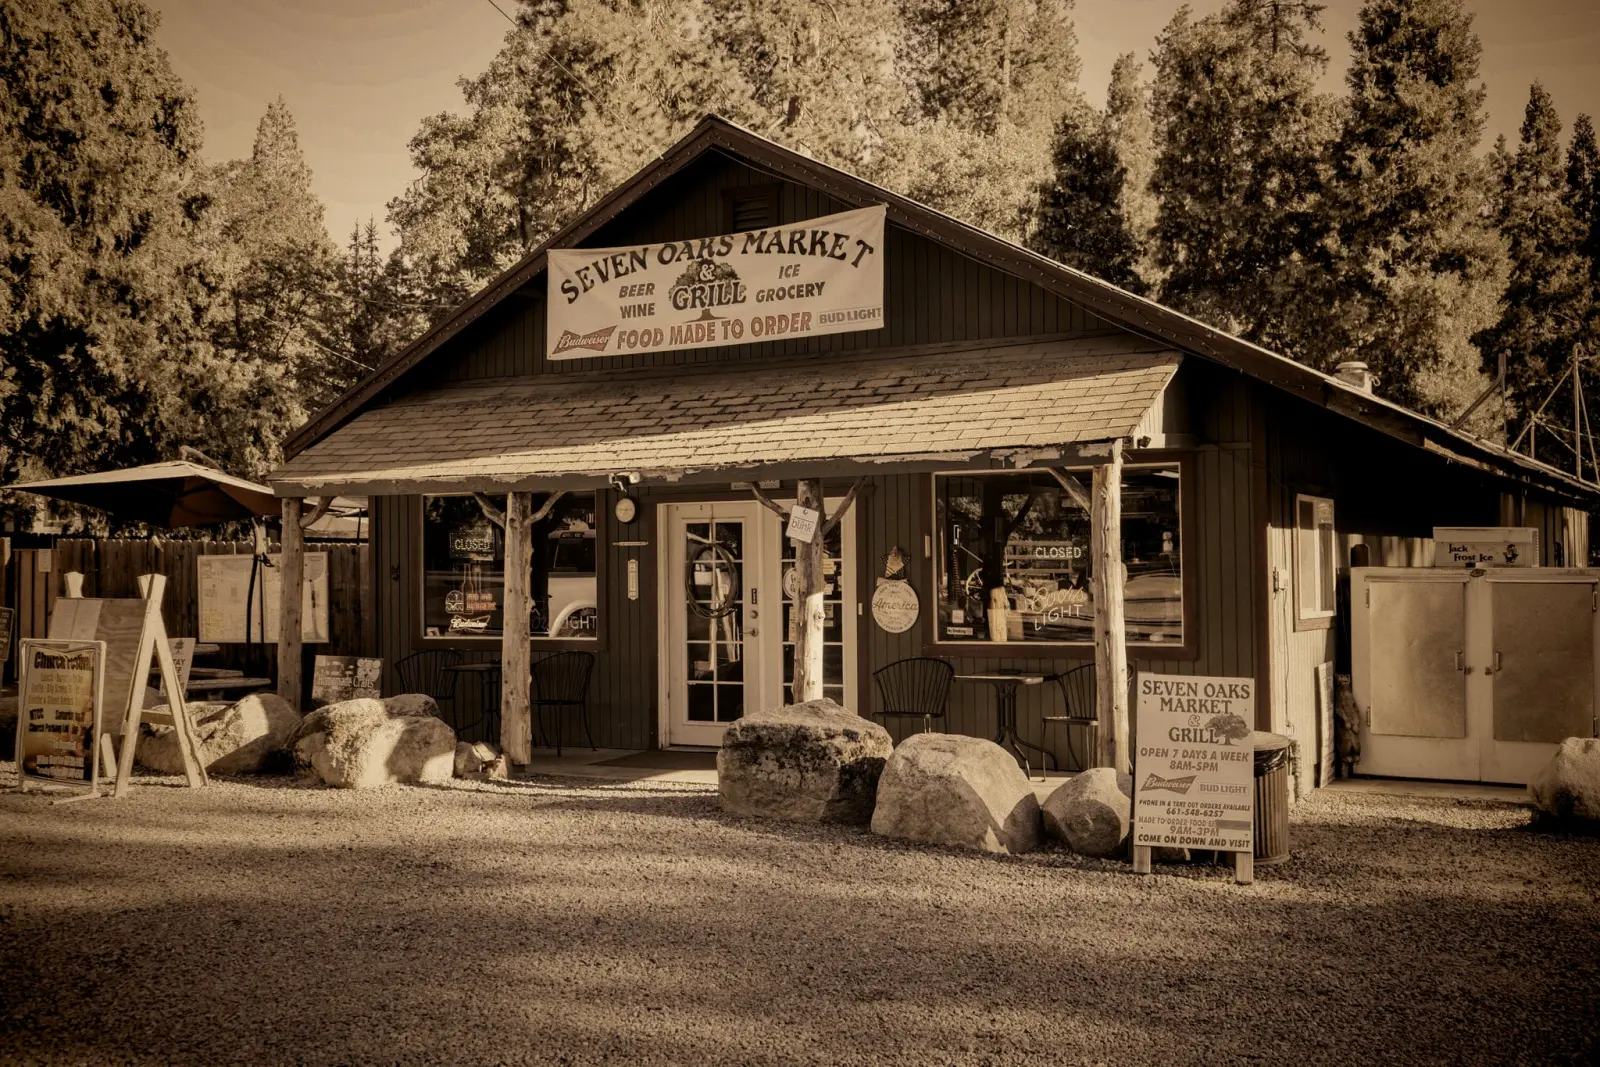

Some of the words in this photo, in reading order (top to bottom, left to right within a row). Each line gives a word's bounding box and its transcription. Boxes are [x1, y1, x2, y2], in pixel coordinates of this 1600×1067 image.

[560, 247, 649, 304] SEVEN
[657, 234, 734, 266] OAKS
[741, 229, 874, 269] MARKET
[699, 263, 715, 281] &
[778, 263, 801, 280] ICE
[618, 282, 655, 299] BEER
[671, 281, 747, 311] GRILL
[755, 281, 826, 303] GROCERY
[619, 302, 655, 319] WINE
[819, 312, 844, 324] BUD
[845, 307, 882, 322] LIGHT
[616, 326, 664, 350] FOOD
[669, 321, 716, 346] MADE
[721, 318, 745, 340] TO
[750, 312, 812, 337] ORDER
[557, 333, 611, 349] Budweiser
[454, 538, 490, 550] CLOSED
[1448, 543, 1468, 554] Jack
[1035, 547, 1082, 558] CLOSED
[1453, 553, 1475, 562] Frost
[1479, 553, 1493, 562] Ice
[872, 597, 918, 612] America
[1034, 604, 1083, 631] LIGHT
[1142, 680, 1199, 697] SEVEN
[1203, 683, 1251, 699] OAKS
[1159, 697, 1232, 714] MARKET
[1188, 714, 1200, 727] &
[1168, 726, 1220, 744] GRILL
[1140, 747, 1169, 759] OPEN
[1172, 749, 1179, 759] 7
[1182, 749, 1208, 760] DAYS
[1210, 750, 1217, 760] A
[1220, 751, 1250, 763] WEEK
[1169, 760, 1219, 772] 8AM-5PM
[1145, 775, 1191, 789] Budweiser
[1199, 783, 1219, 793] BUD
[1220, 785, 1248, 794] LIGHT
[1166, 808, 1224, 818] 661-548-6257
[1138, 816, 1155, 824] MADE
[1167, 818, 1187, 826] ORDER
[1189, 819, 1206, 827] FOOD
[1169, 825, 1220, 837] 9AM-3PM
[1138, 834, 1161, 843] COME
[1164, 835, 1177, 843] ON
[1179, 836, 1206, 846] DOWN
[1209, 838, 1227, 847] AND
[1229, 839, 1251, 848] VISIT
